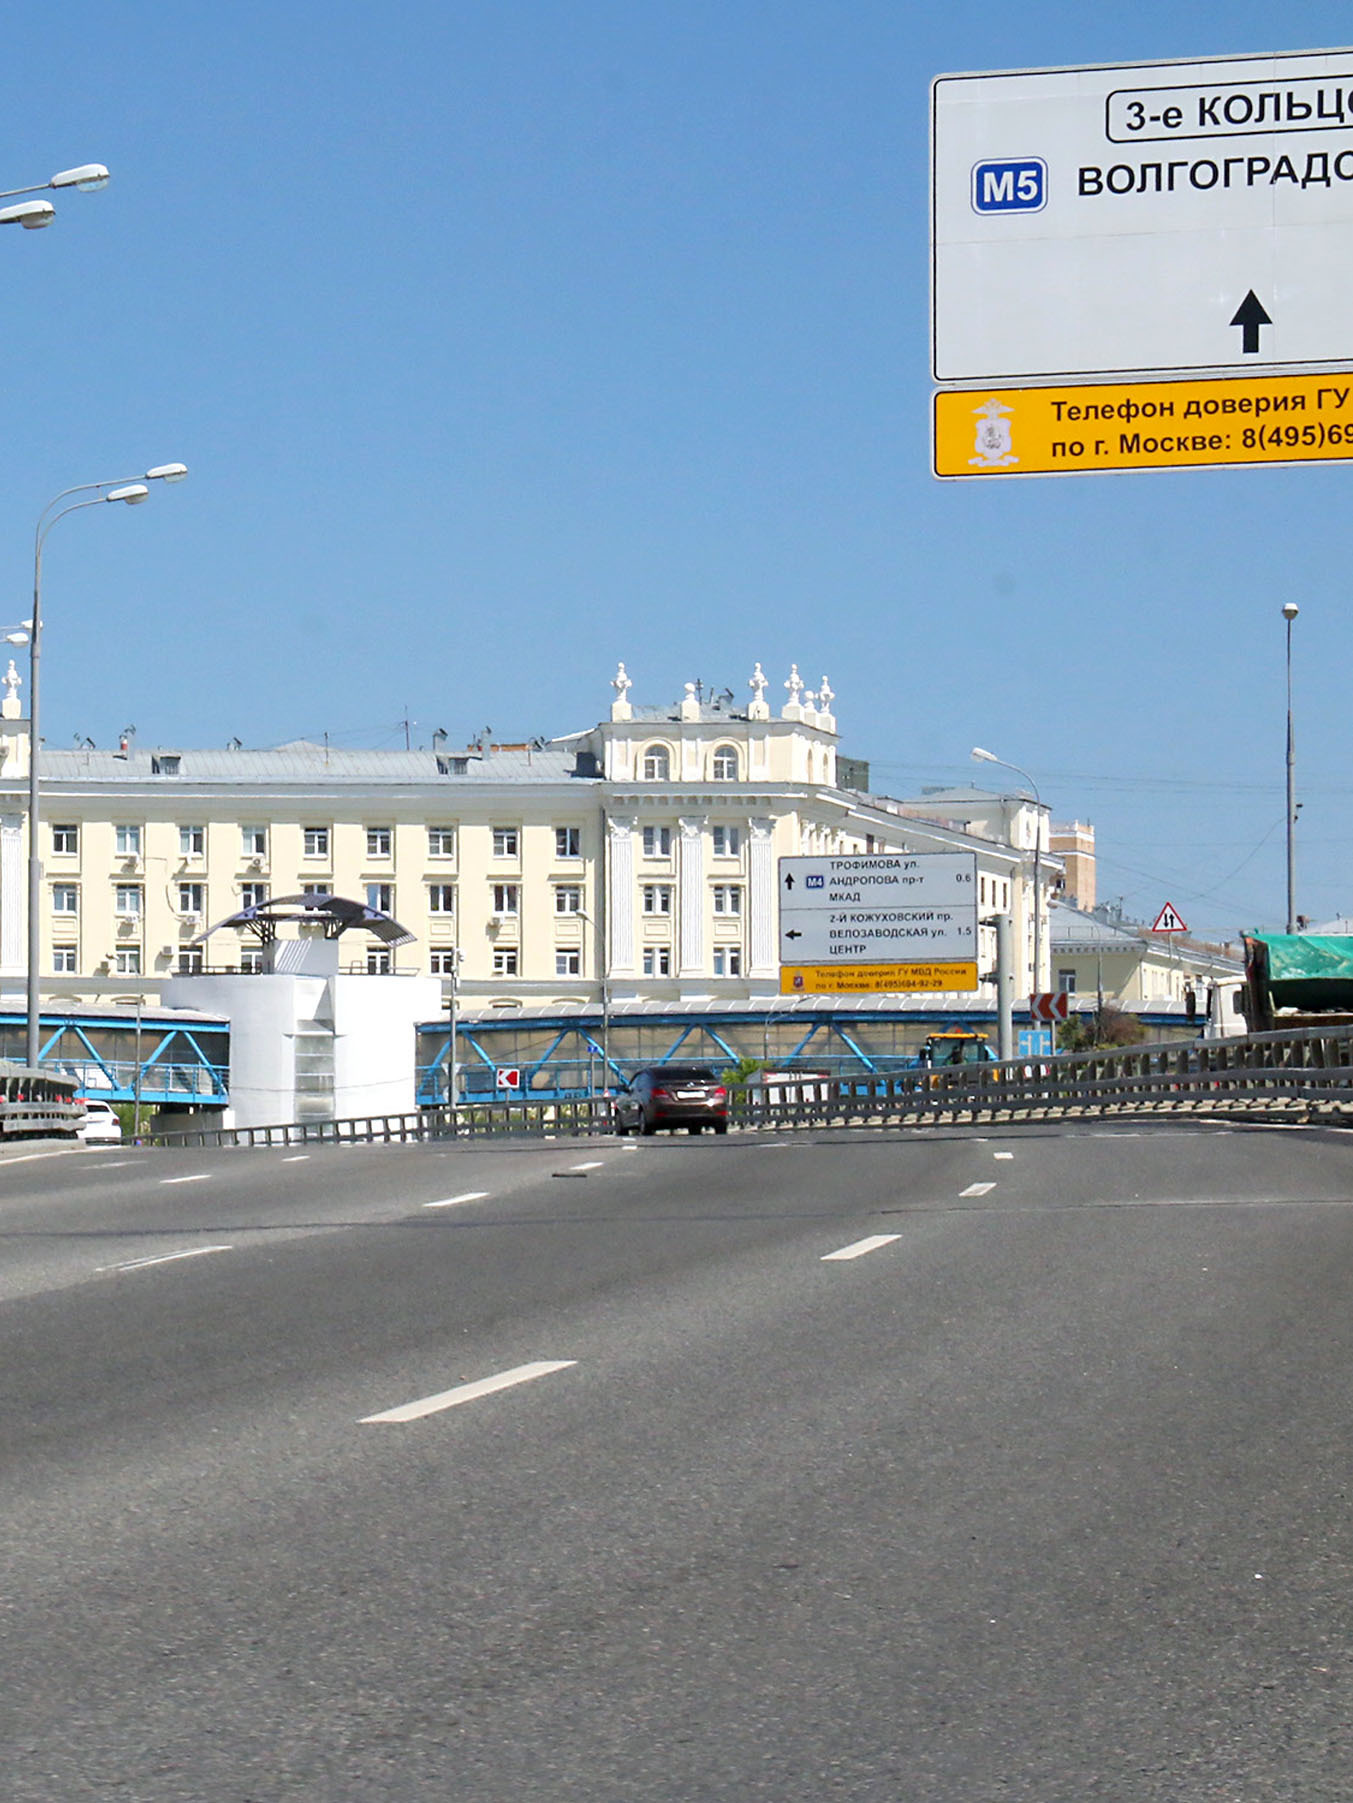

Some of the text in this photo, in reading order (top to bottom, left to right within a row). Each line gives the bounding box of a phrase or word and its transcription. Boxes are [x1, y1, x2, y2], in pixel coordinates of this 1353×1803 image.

[1125, 88, 1353, 132] 3-е КОЛЬЦ
[982, 149, 1353, 203] М5 ВОЛГОГРАДО
[1051, 388, 1351, 424] Телефон доверия ГУ
[1051, 422, 1353, 459] по г. Москве: 8(495)69
[830, 860, 901, 870] ТРОФИМОВА
[829, 876, 899, 886] АНДРОПОВА
[829, 892, 861, 903] МКАД
[850, 911, 934, 923] КОЖУХОВСКИЙ
[829, 927, 928, 939] ВЕЛОЗАВОДСКАЯ
[829, 944, 866, 956] ЦЕНТР
